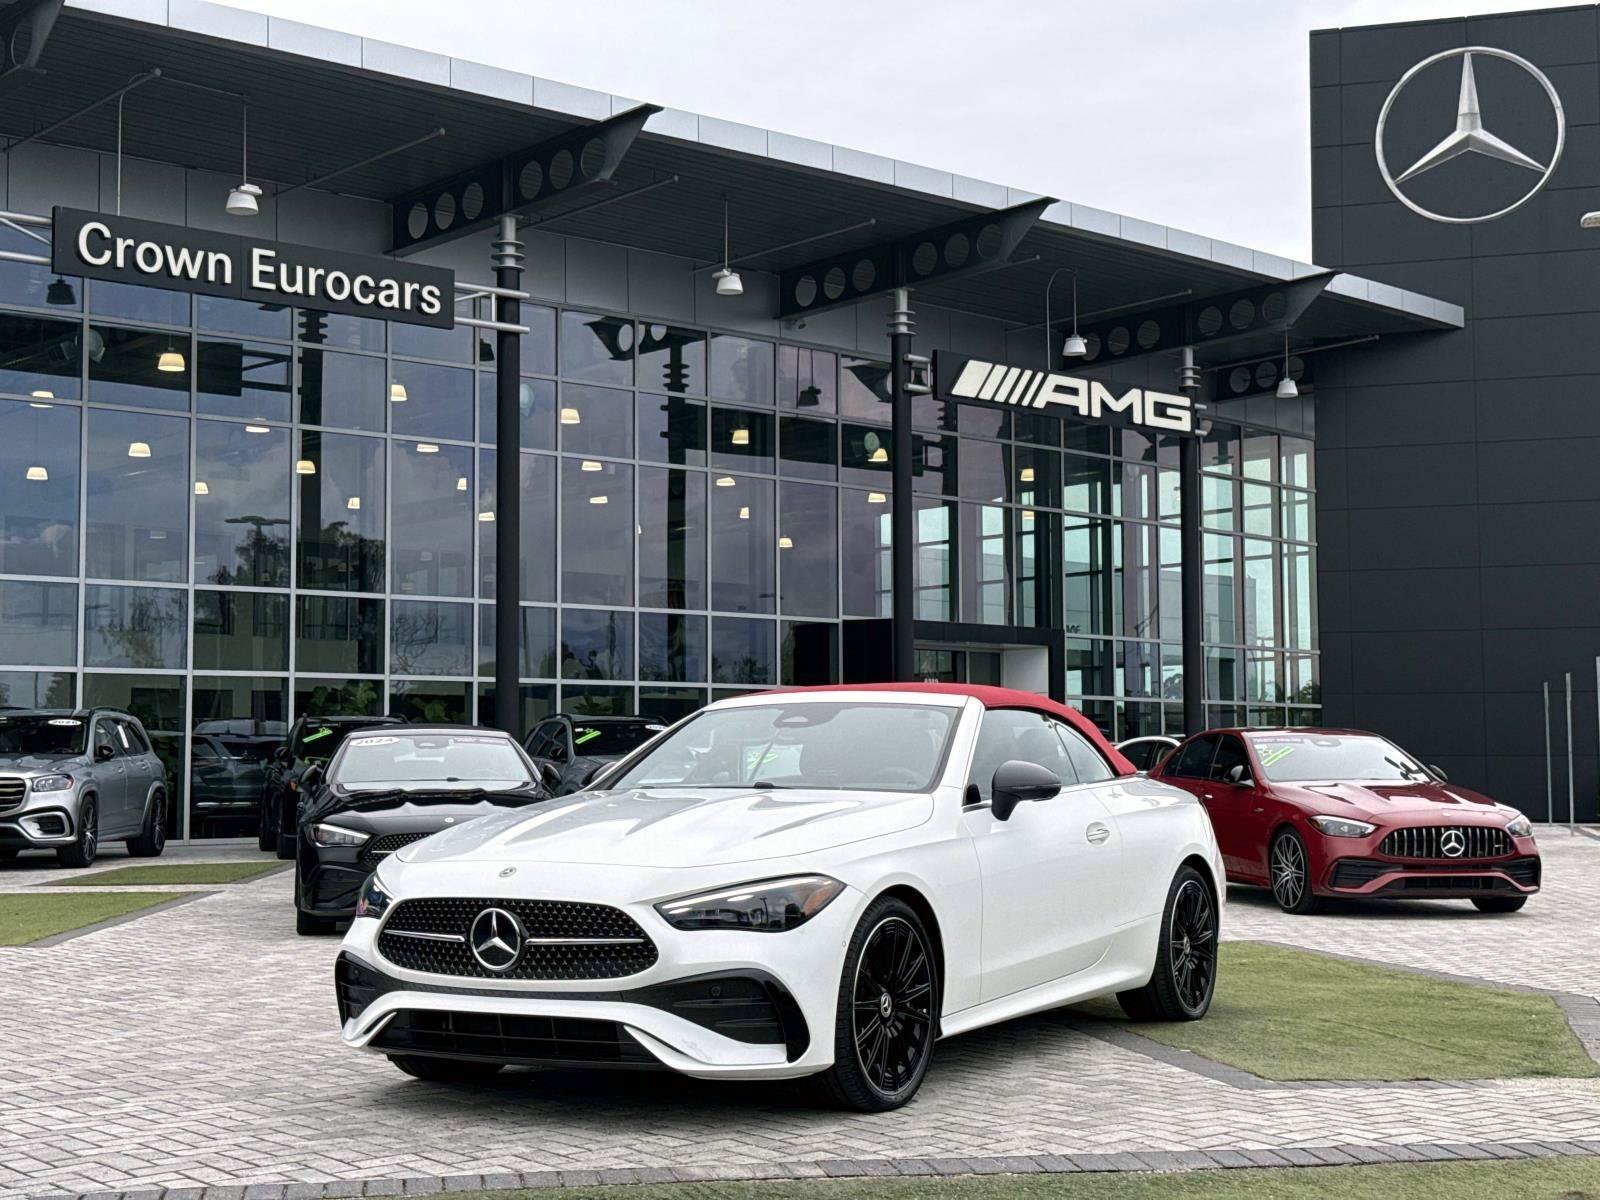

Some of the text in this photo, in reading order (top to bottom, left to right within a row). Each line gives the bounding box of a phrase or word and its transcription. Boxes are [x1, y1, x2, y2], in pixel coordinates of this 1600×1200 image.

[77, 221, 442, 315] Crown Eurocars
[1032, 373, 1192, 432] AMG
